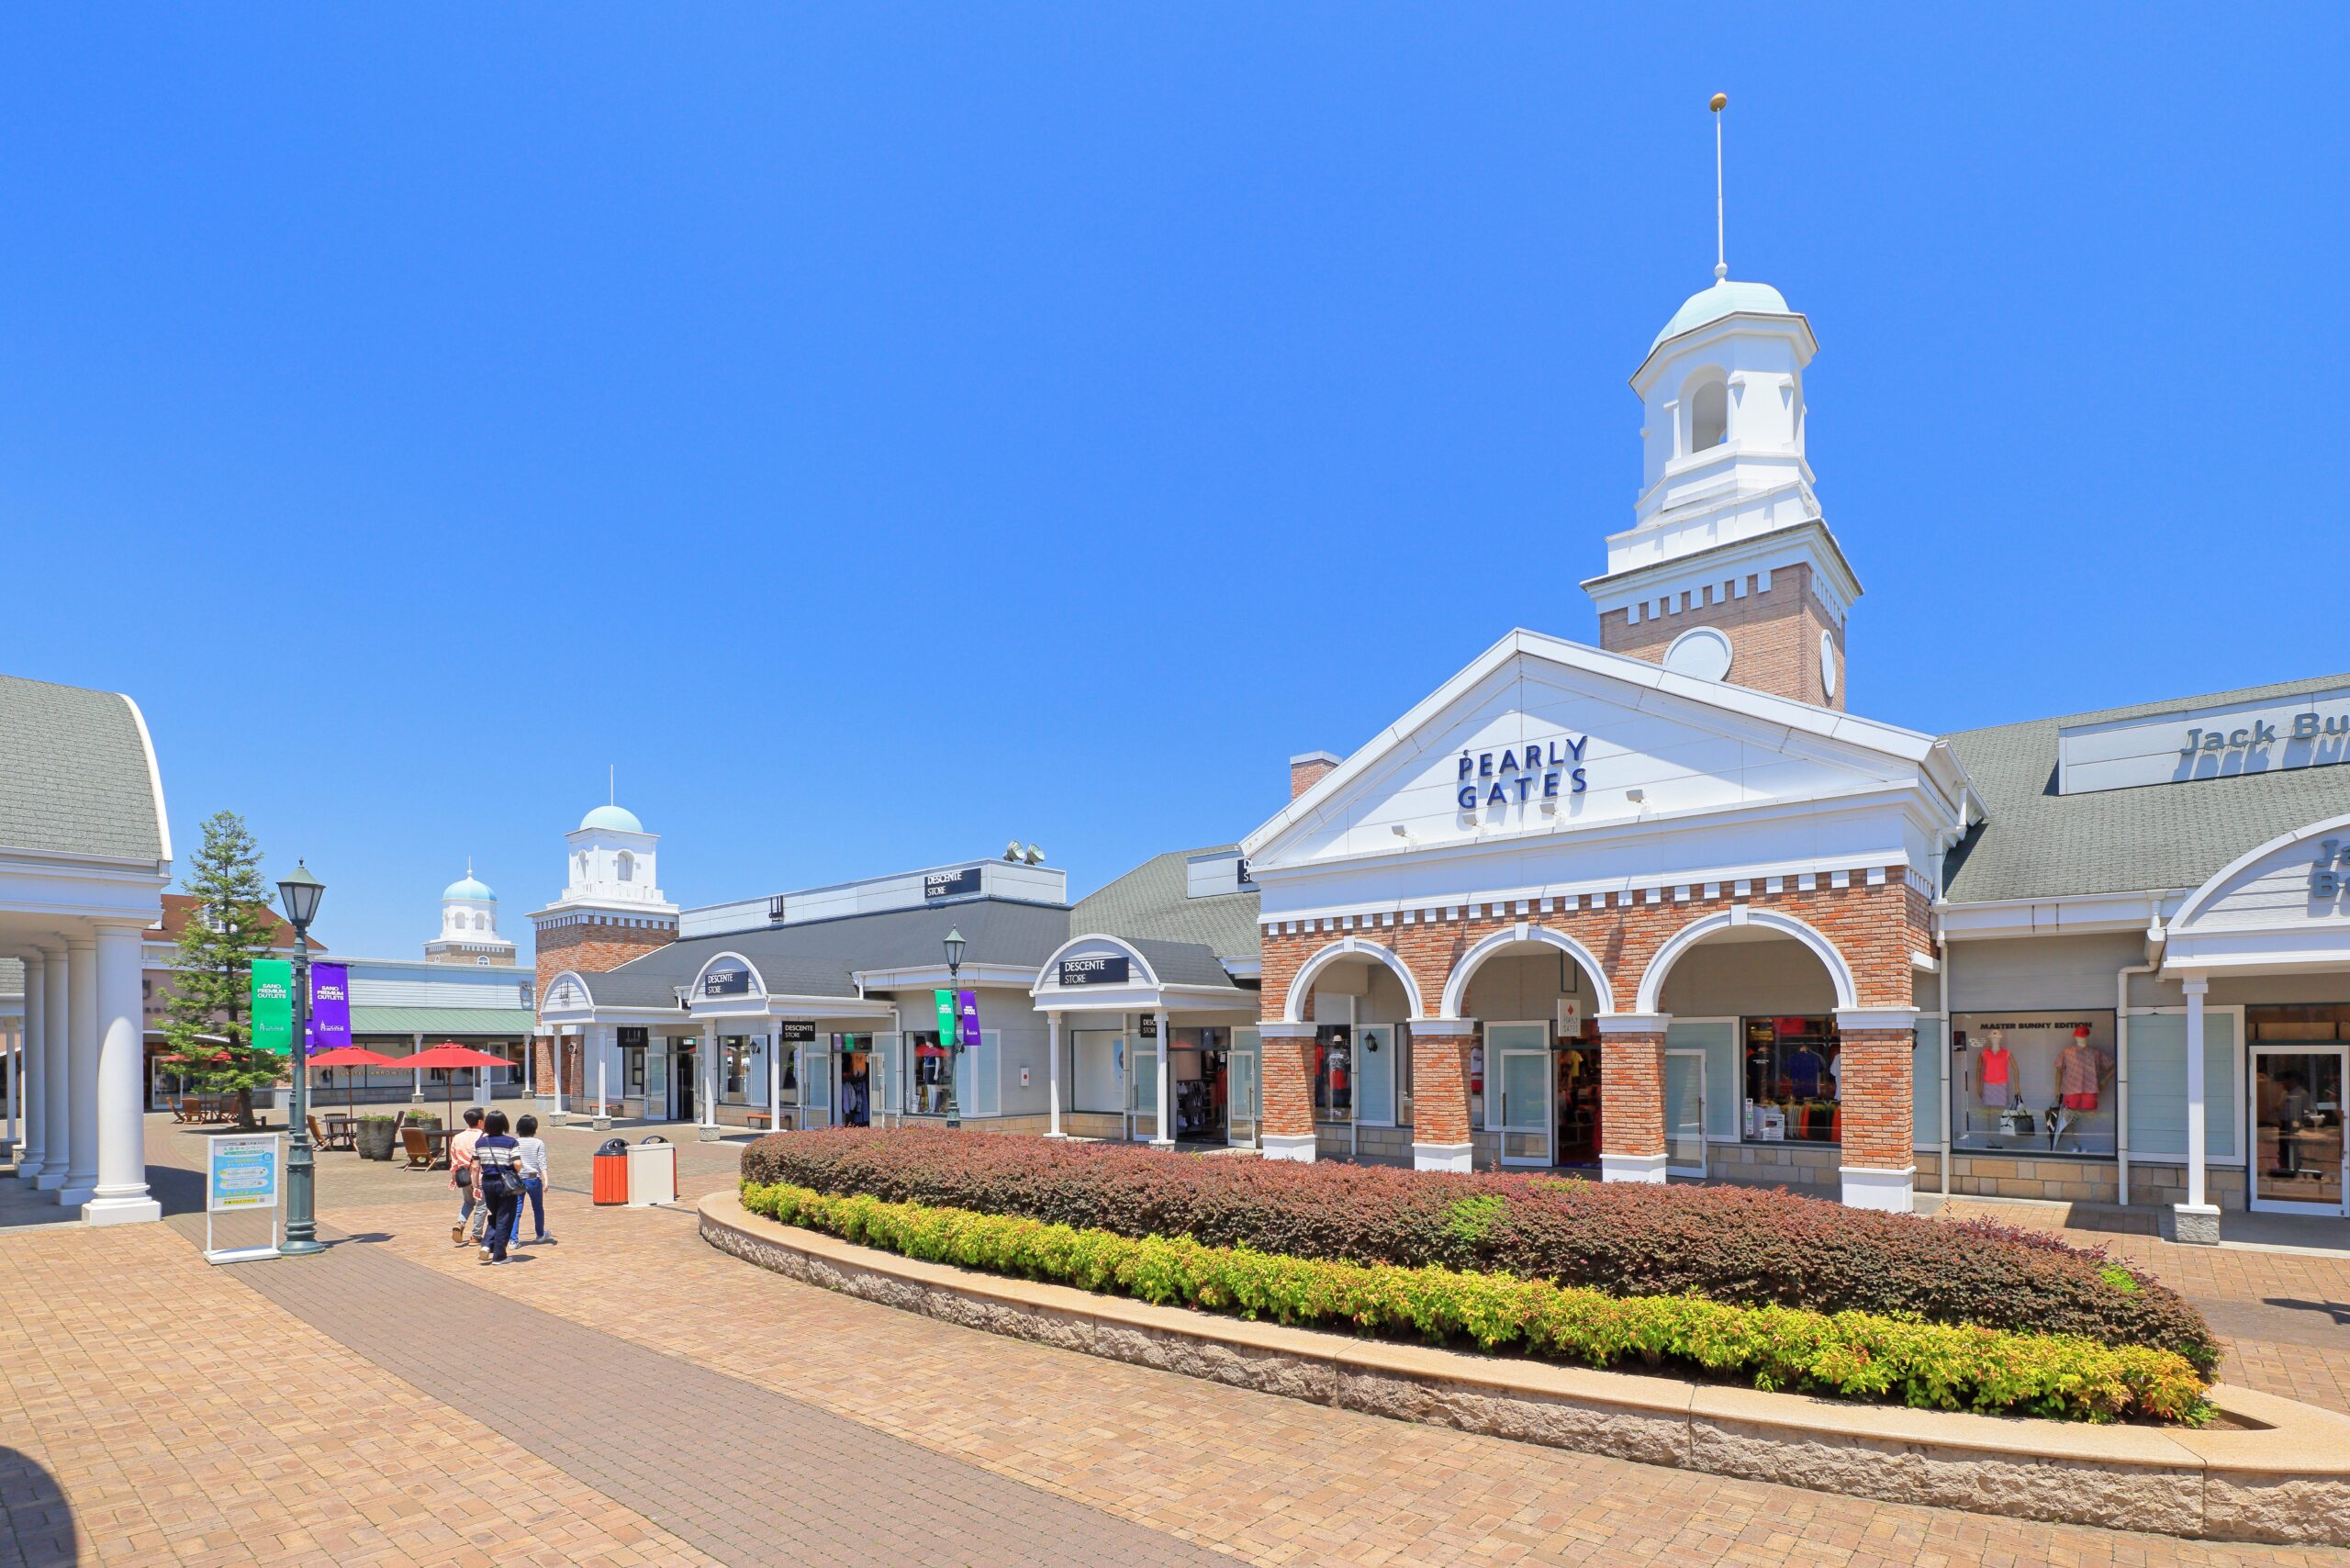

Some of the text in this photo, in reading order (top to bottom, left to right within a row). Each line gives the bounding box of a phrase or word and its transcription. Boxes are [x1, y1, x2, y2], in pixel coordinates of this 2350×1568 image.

[2179, 719, 2277, 755] Jack
[1459, 735, 1588, 780] PEARLY
[1458, 767, 1588, 809] GATES
[927, 871, 963, 886] DESCENTE
[927, 885, 946, 897] STORE
[1065, 959, 1105, 972] DESCENTE
[708, 973, 733, 984] DESCENTE
[1065, 973, 1087, 984] STORE
[708, 985, 722, 994] STORE
